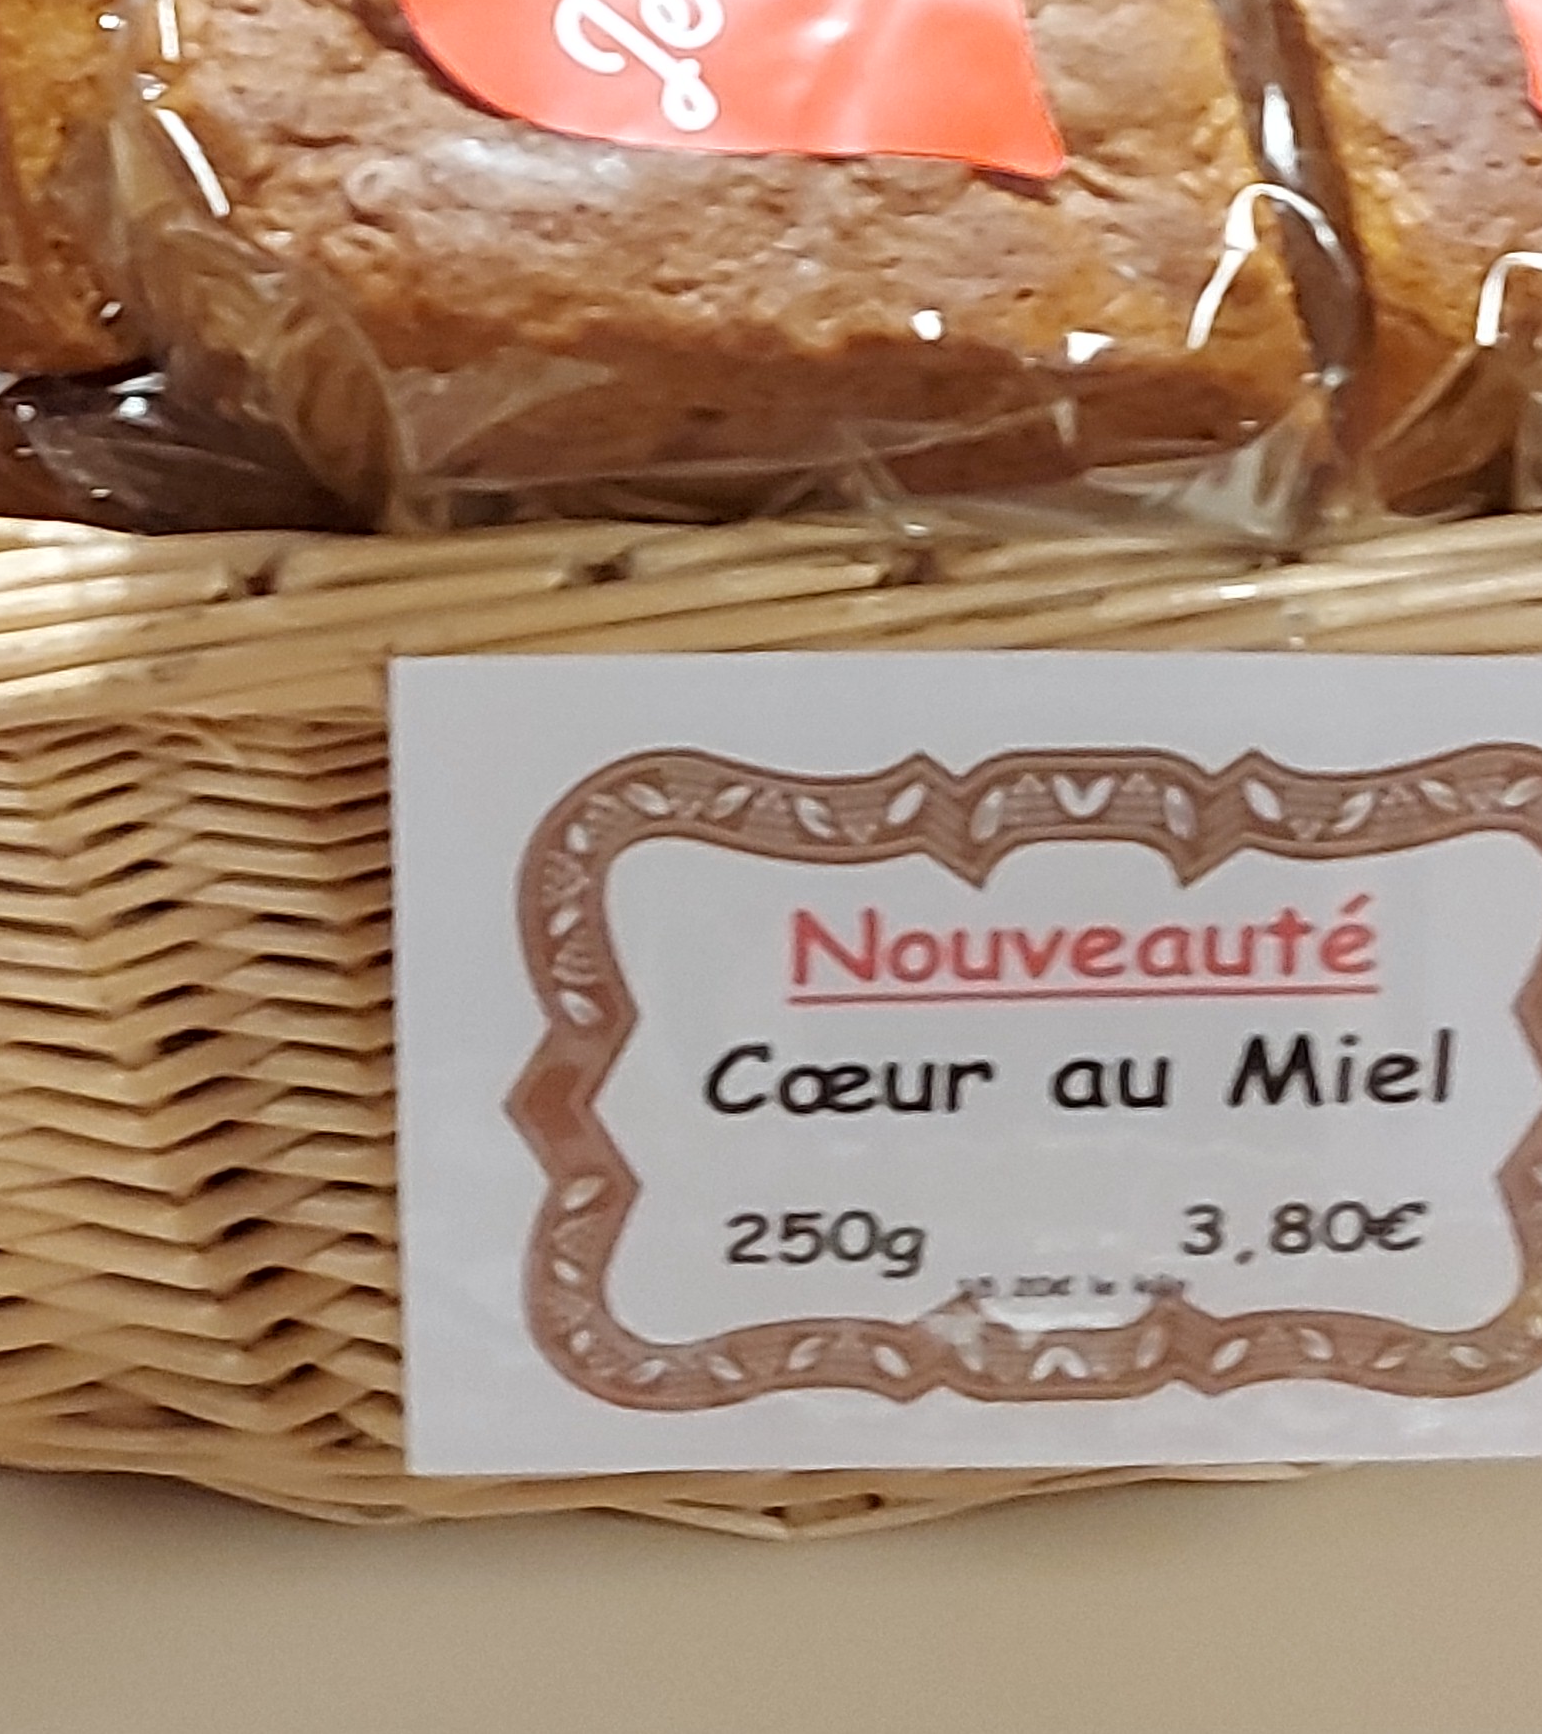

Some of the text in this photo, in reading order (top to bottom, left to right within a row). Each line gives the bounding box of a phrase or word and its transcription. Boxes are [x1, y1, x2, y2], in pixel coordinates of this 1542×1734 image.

[789, 893, 1380, 986] Nouveauté
[703, 1027, 1456, 1115] Cœur au Miel
[725, 1200, 1427, 1279] 250g 3,80€
